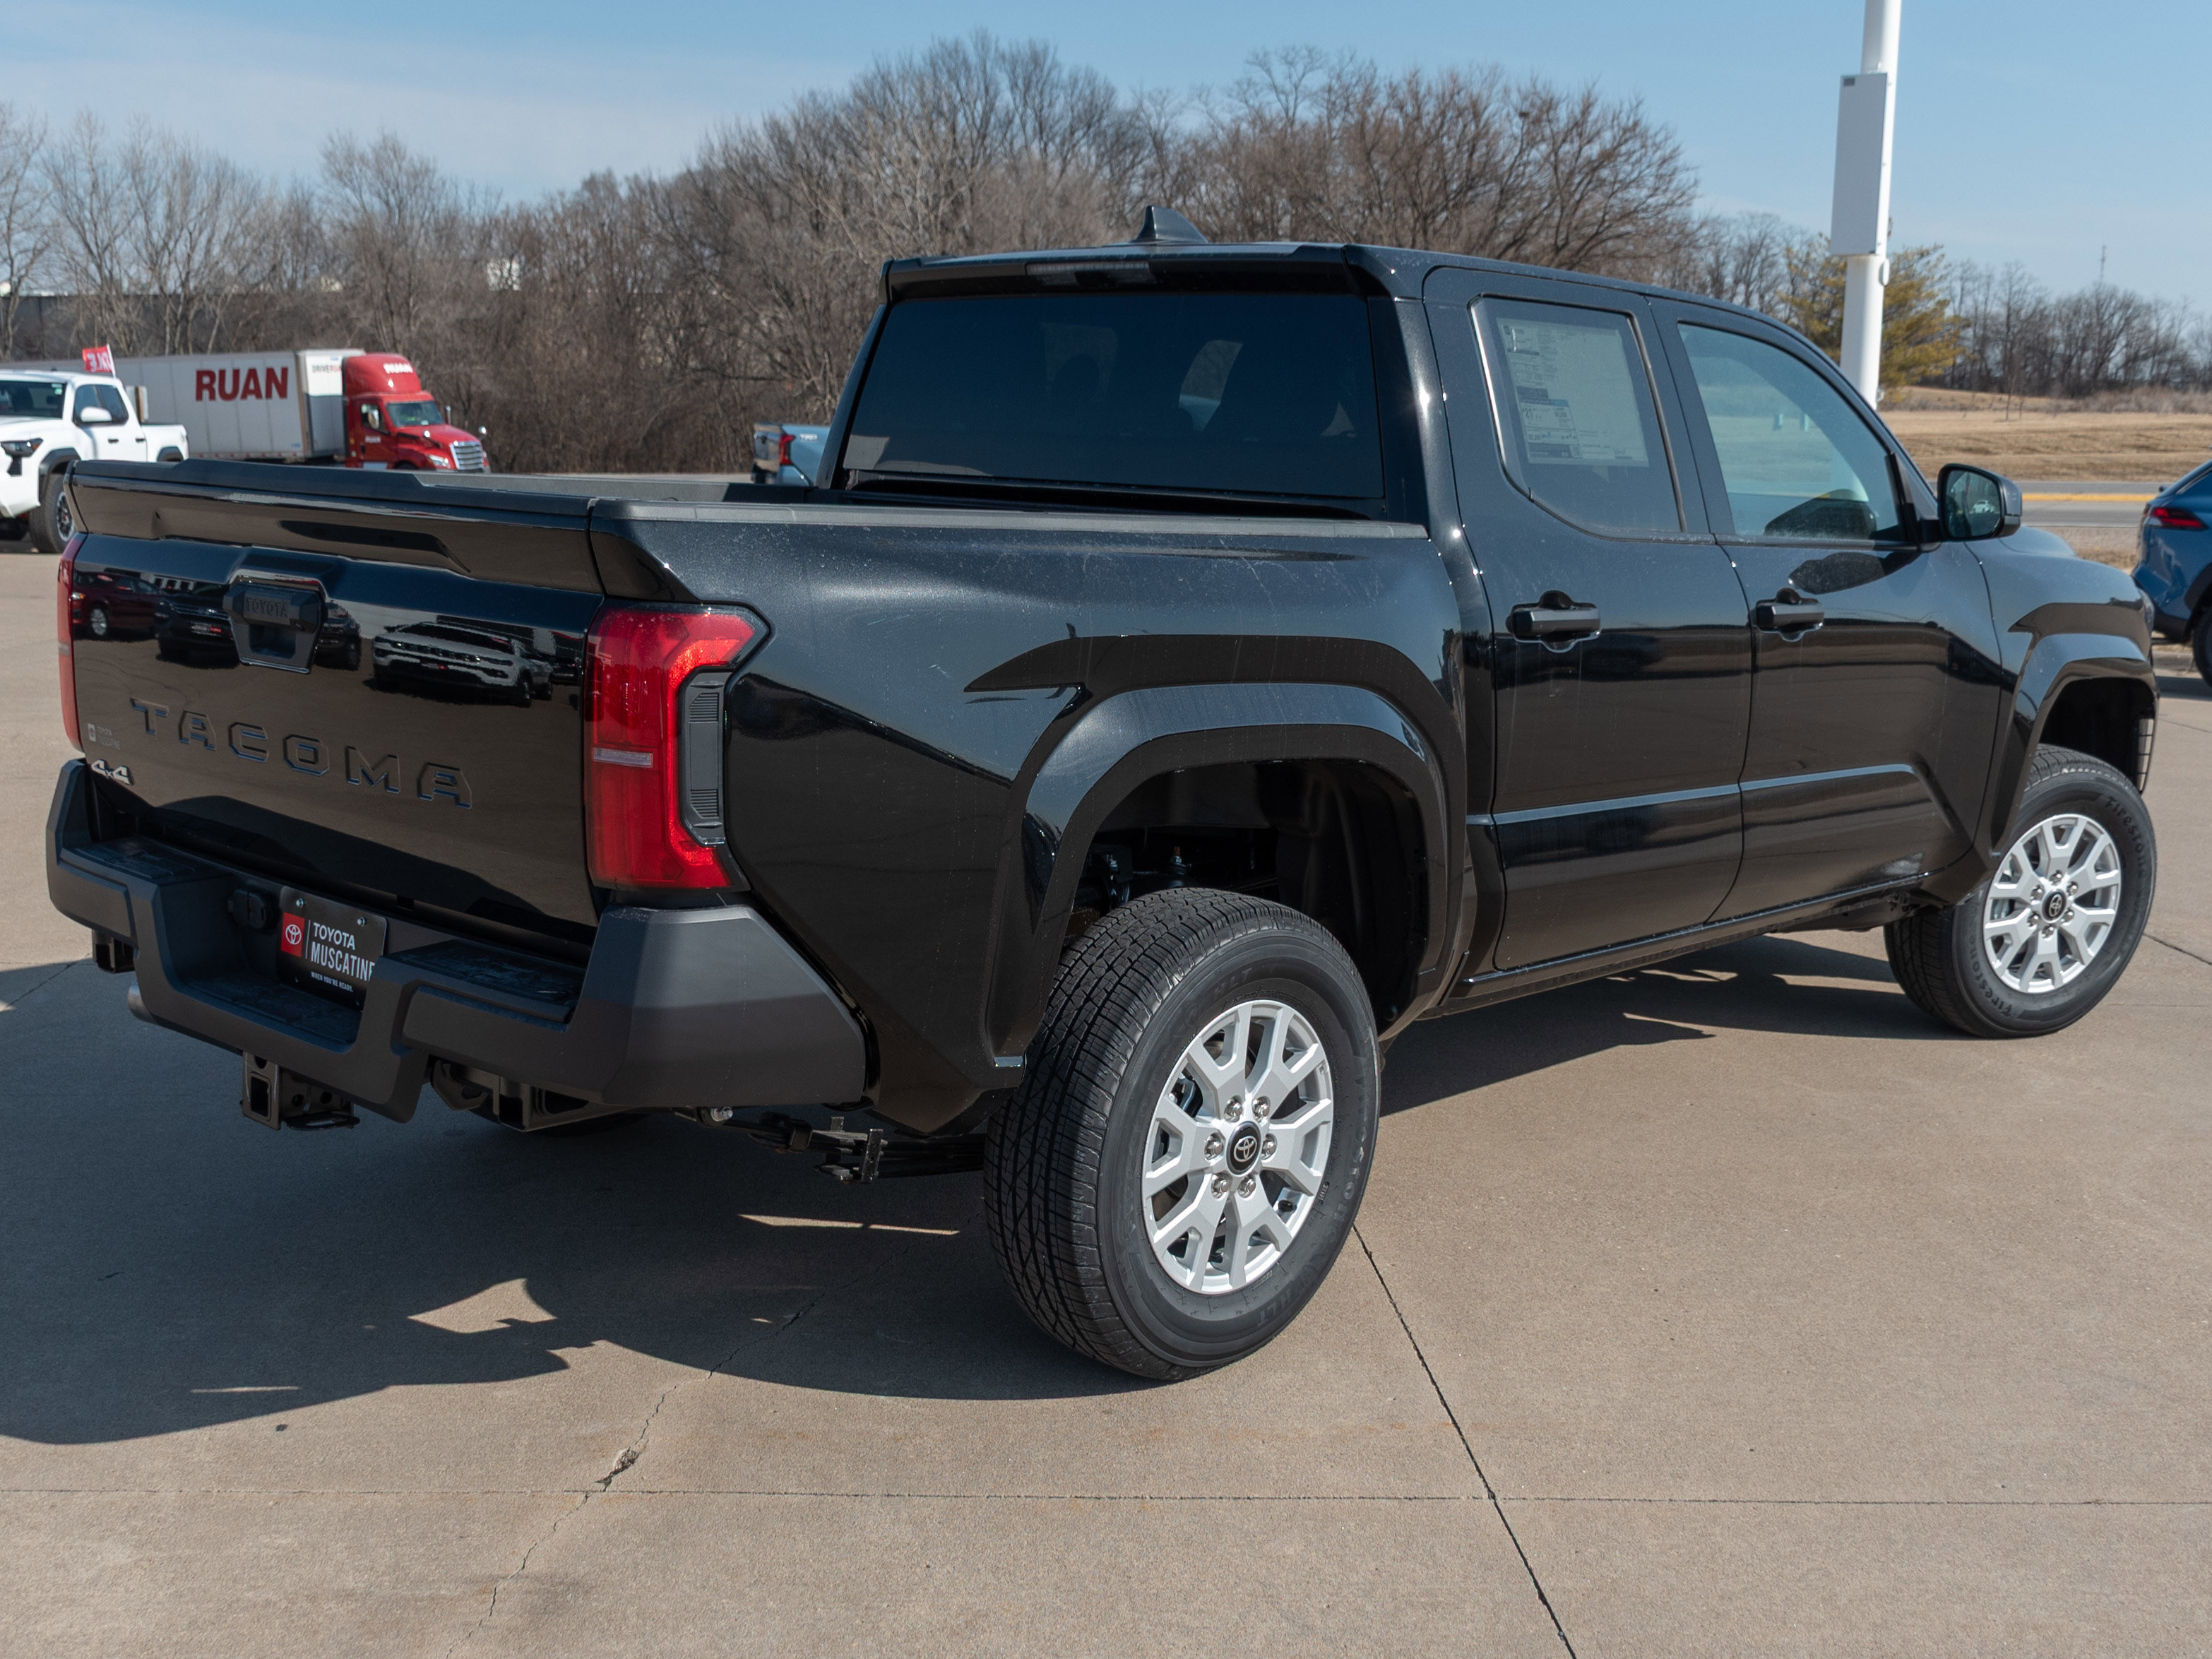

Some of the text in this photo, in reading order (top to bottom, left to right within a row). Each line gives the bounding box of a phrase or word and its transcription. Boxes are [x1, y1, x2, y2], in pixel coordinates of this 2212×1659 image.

[383, 363, 413, 374] RUAN
[196, 367, 288, 402] RUAN
[246, 598, 288, 618] TOYOTA
[130, 697, 472, 809] TACOMA
[2104, 796, 2147, 878] Firestone
[313, 922, 355, 950] TOYOTA
[311, 971, 323, 981] WHEN
[324, 975, 338, 987] YOU'RE
